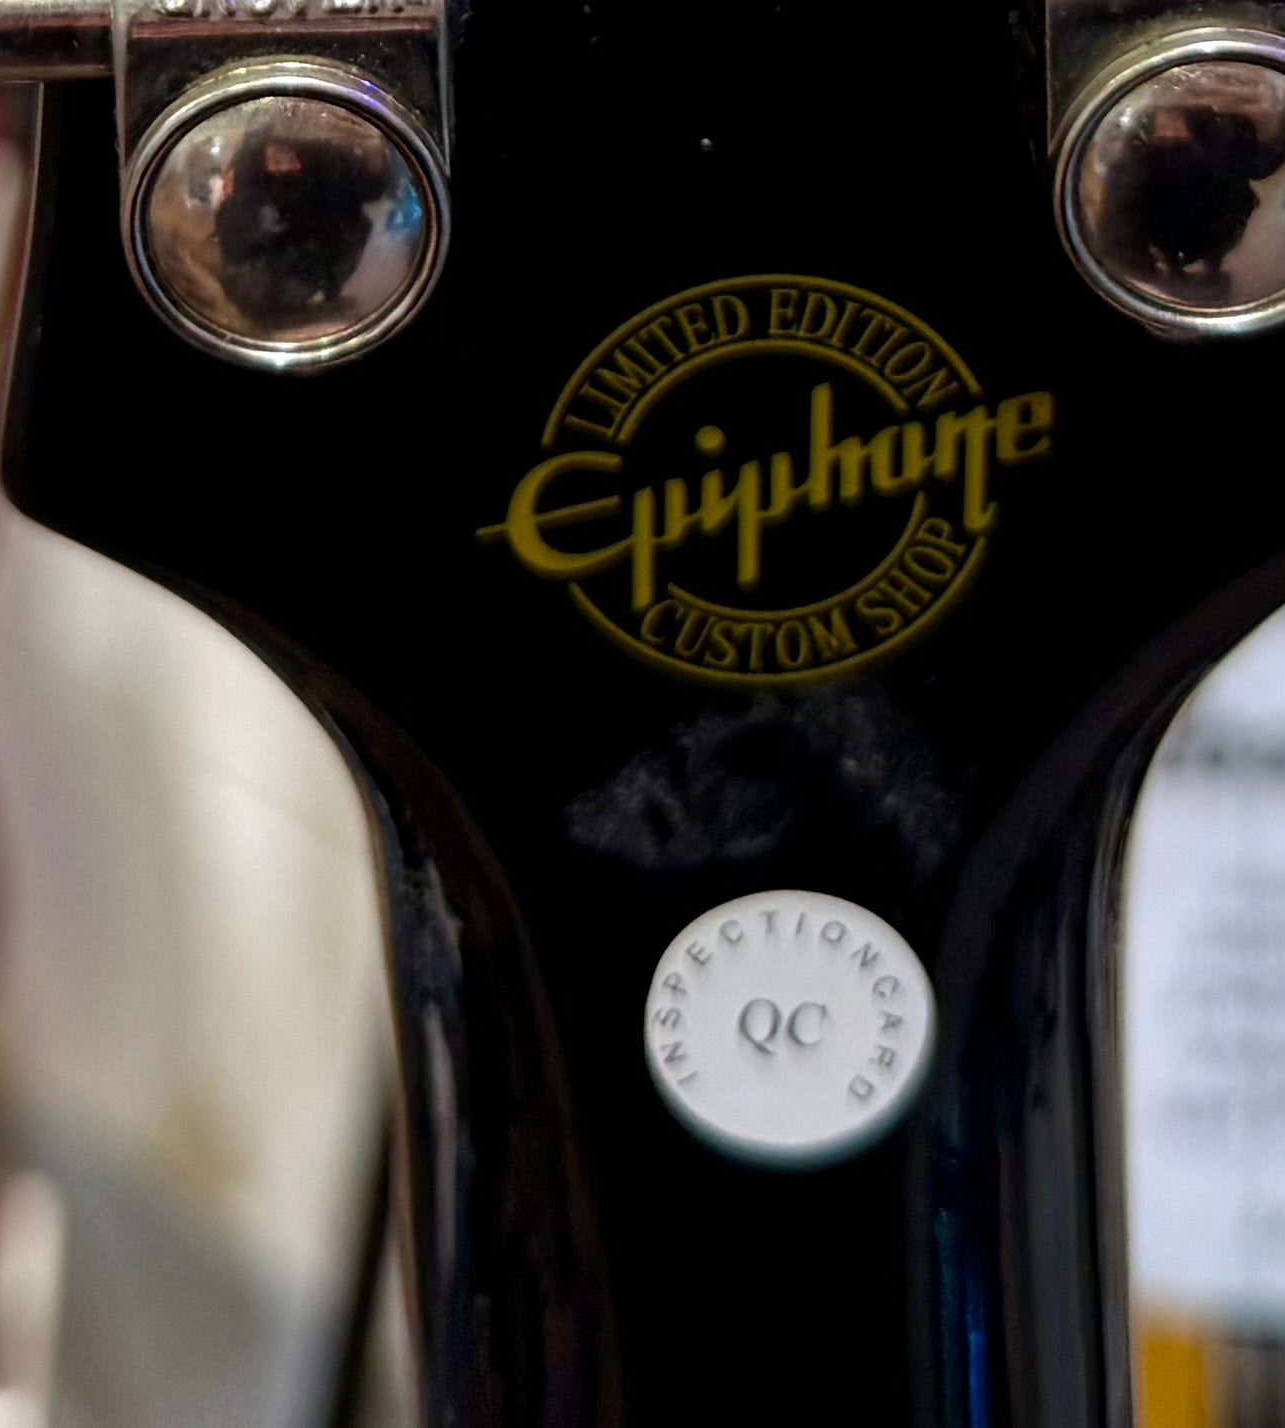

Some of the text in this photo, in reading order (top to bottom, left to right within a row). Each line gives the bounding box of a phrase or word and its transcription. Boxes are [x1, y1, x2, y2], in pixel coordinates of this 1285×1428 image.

[564, 288, 958, 438] LIMITED EDITION
[475, 381, 1054, 611] Epiphone
[640, 517, 966, 673] CUSTOM SHOP
[738, 997, 828, 1056] QC
